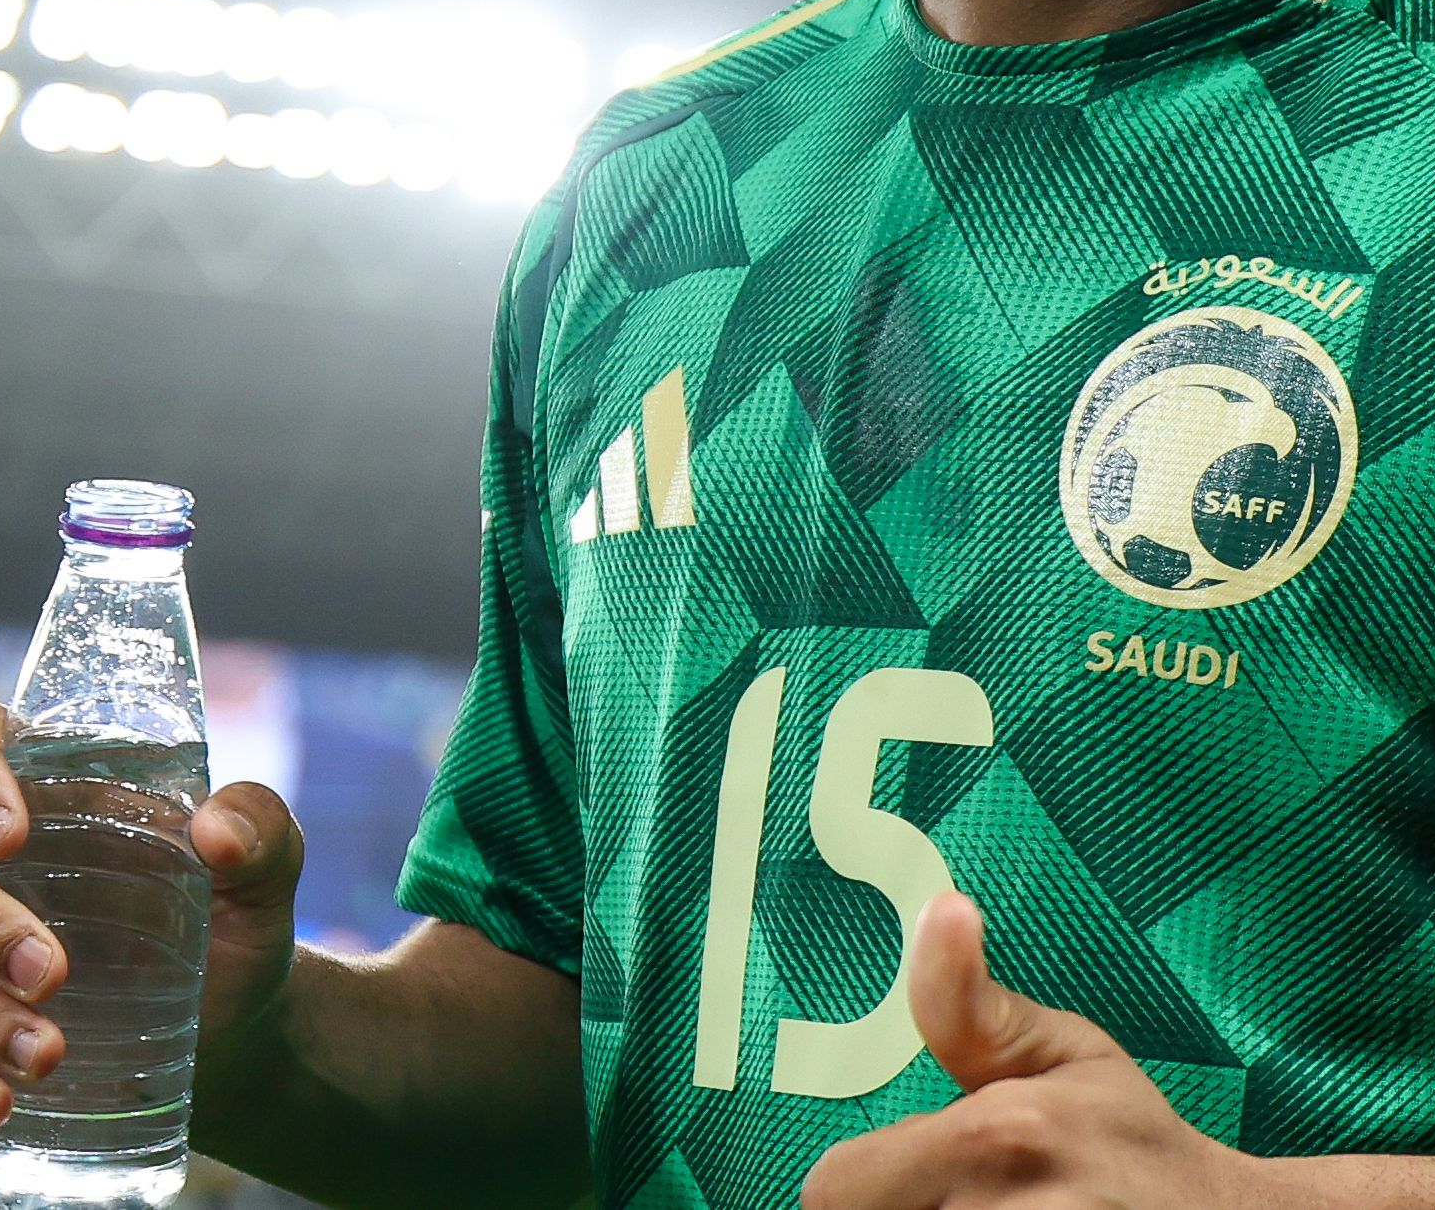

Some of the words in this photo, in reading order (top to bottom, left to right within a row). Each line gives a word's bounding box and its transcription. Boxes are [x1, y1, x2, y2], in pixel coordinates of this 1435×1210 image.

[1143, 255, 1364, 320] السعودية
[1200, 490, 1286, 523] SAFF
[1084, 630, 1240, 689] SAUDI
[692, 666, 994, 1099] 15
